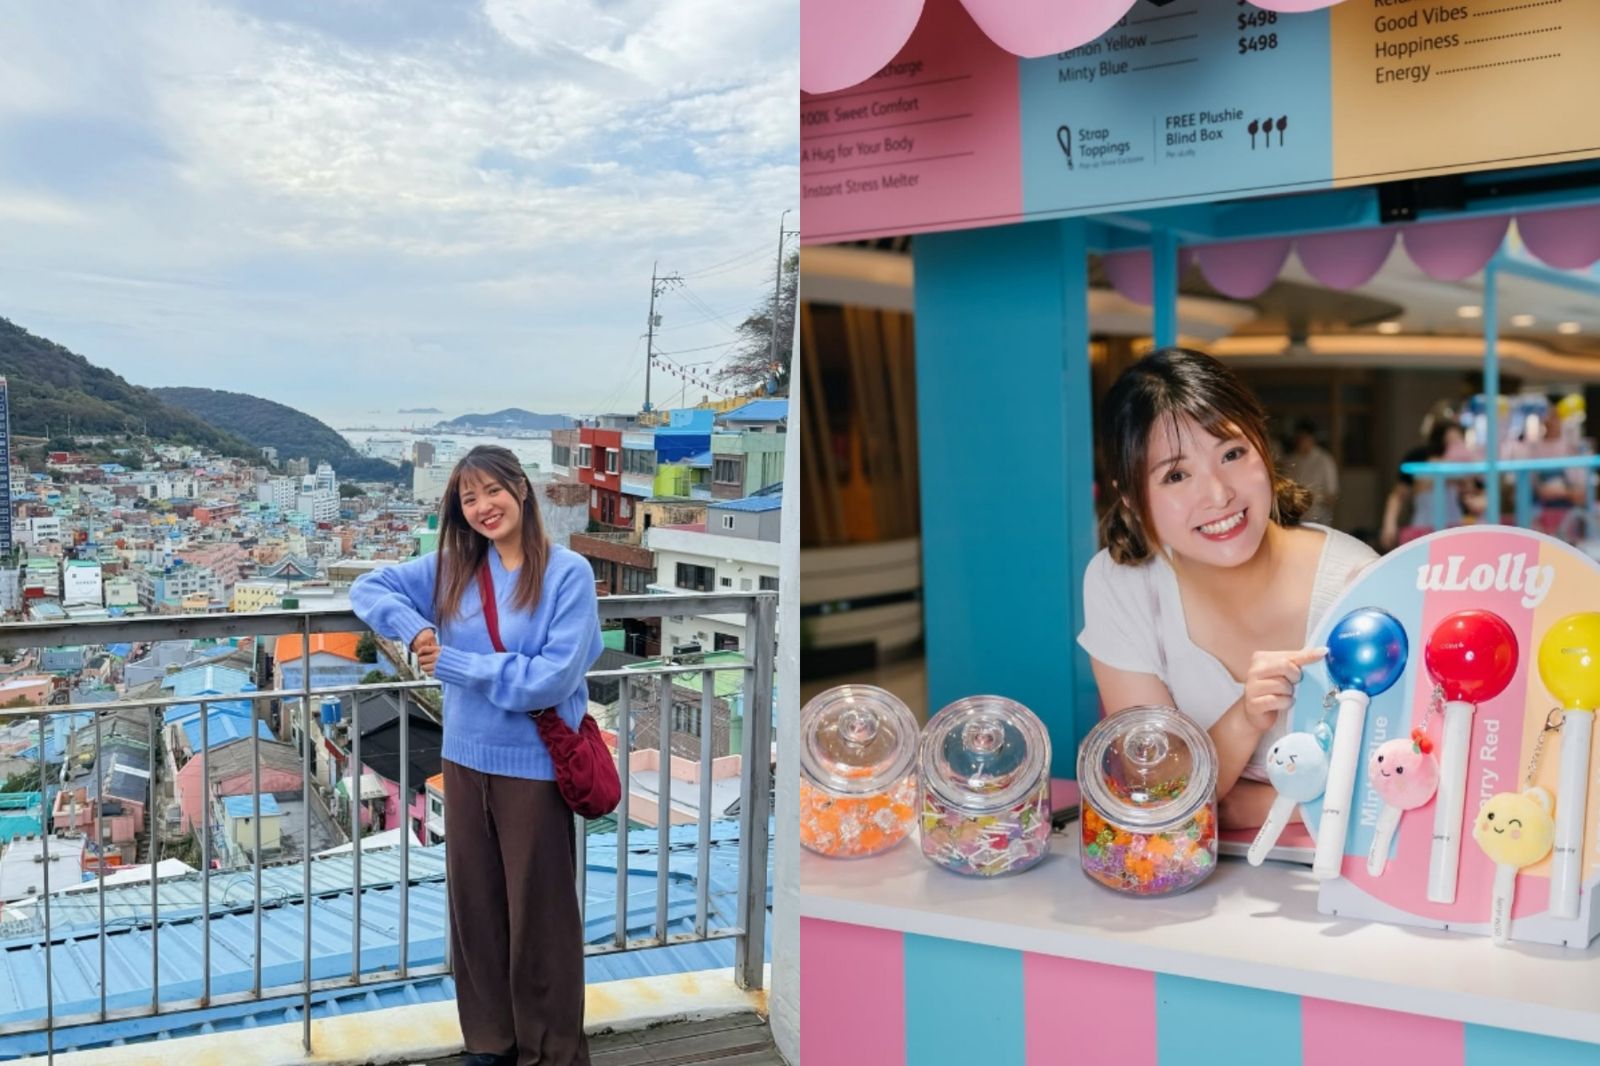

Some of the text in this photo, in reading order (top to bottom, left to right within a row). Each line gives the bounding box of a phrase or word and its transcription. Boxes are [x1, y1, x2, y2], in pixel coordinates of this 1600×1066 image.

[1238, 10, 1277, 30] $498
[1374, 6, 1468, 33] Good Vibes
[1105, 34, 1148, 52] Yellow
[1238, 32, 1278, 55] $498
[1375, 34, 1459, 60] Happiness
[1058, 60, 1128, 84] Minty Blue
[1376, 64, 1431, 84] Energy
[834, 105, 868, 122] Sweet
[871, 97, 919, 117] Comfort
[1166, 108, 1244, 129] FREE Plushie
[1078, 128, 1109, 142] Strap
[1166, 128, 1223, 146] Blind Box
[801, 135, 914, 164] A Hug for Your Body
[1078, 141, 1131, 158] Toppings
[802, 174, 919, 199] Instant Stress Melter
[1416, 553, 1555, 609] uLolly
[1480, 720, 1500, 761] Red
